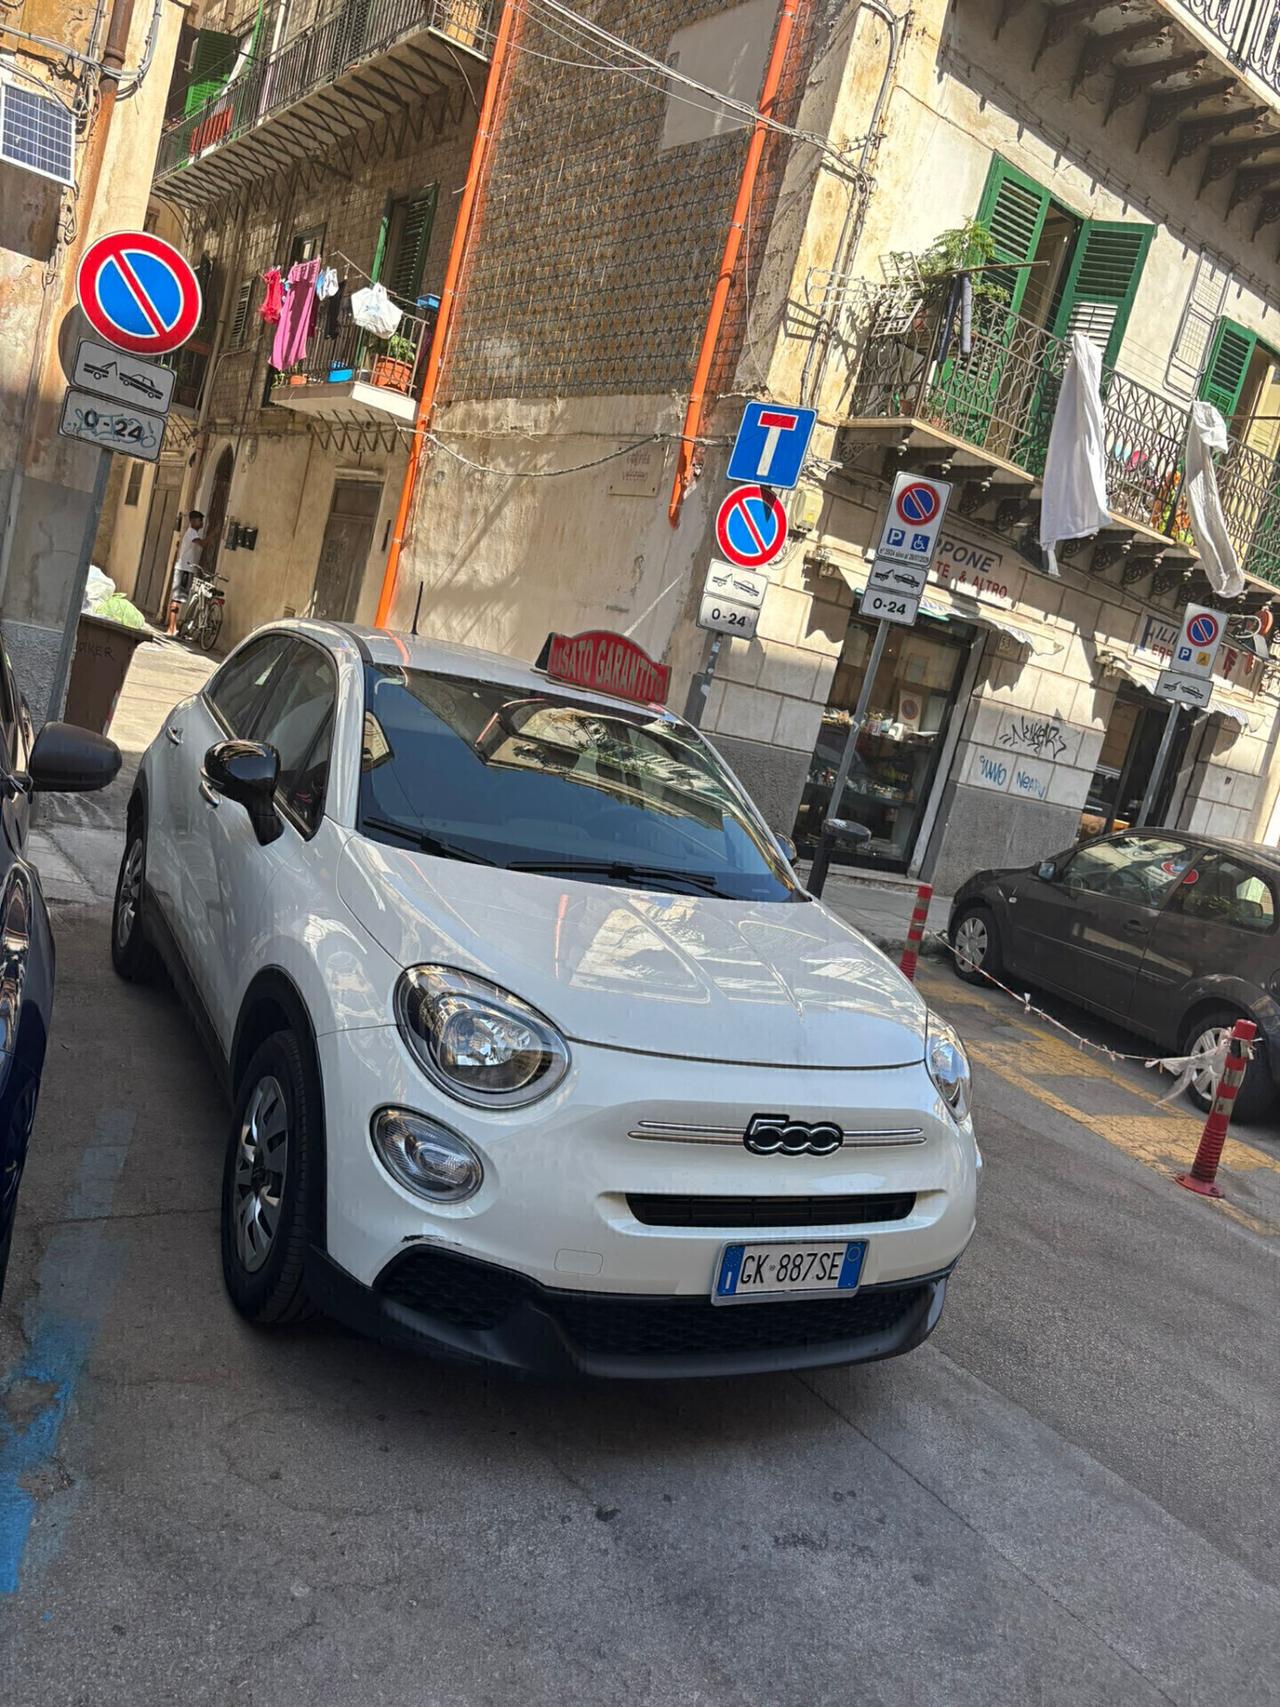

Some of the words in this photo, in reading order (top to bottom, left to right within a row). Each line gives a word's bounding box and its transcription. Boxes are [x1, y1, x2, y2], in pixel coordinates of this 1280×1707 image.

[958, 570, 967, 583] &
[972, 575, 1008, 599] ALTRO
[711, 608, 747, 628] 0-24
[873, 598, 906, 615] 0-24
[554, 639, 594, 682] USATO
[595, 639, 666, 701] GARANTITO
[746, 1115, 842, 1154] 500
[741, 1254, 770, 1284] GK
[776, 1252, 844, 1282] 887SE
